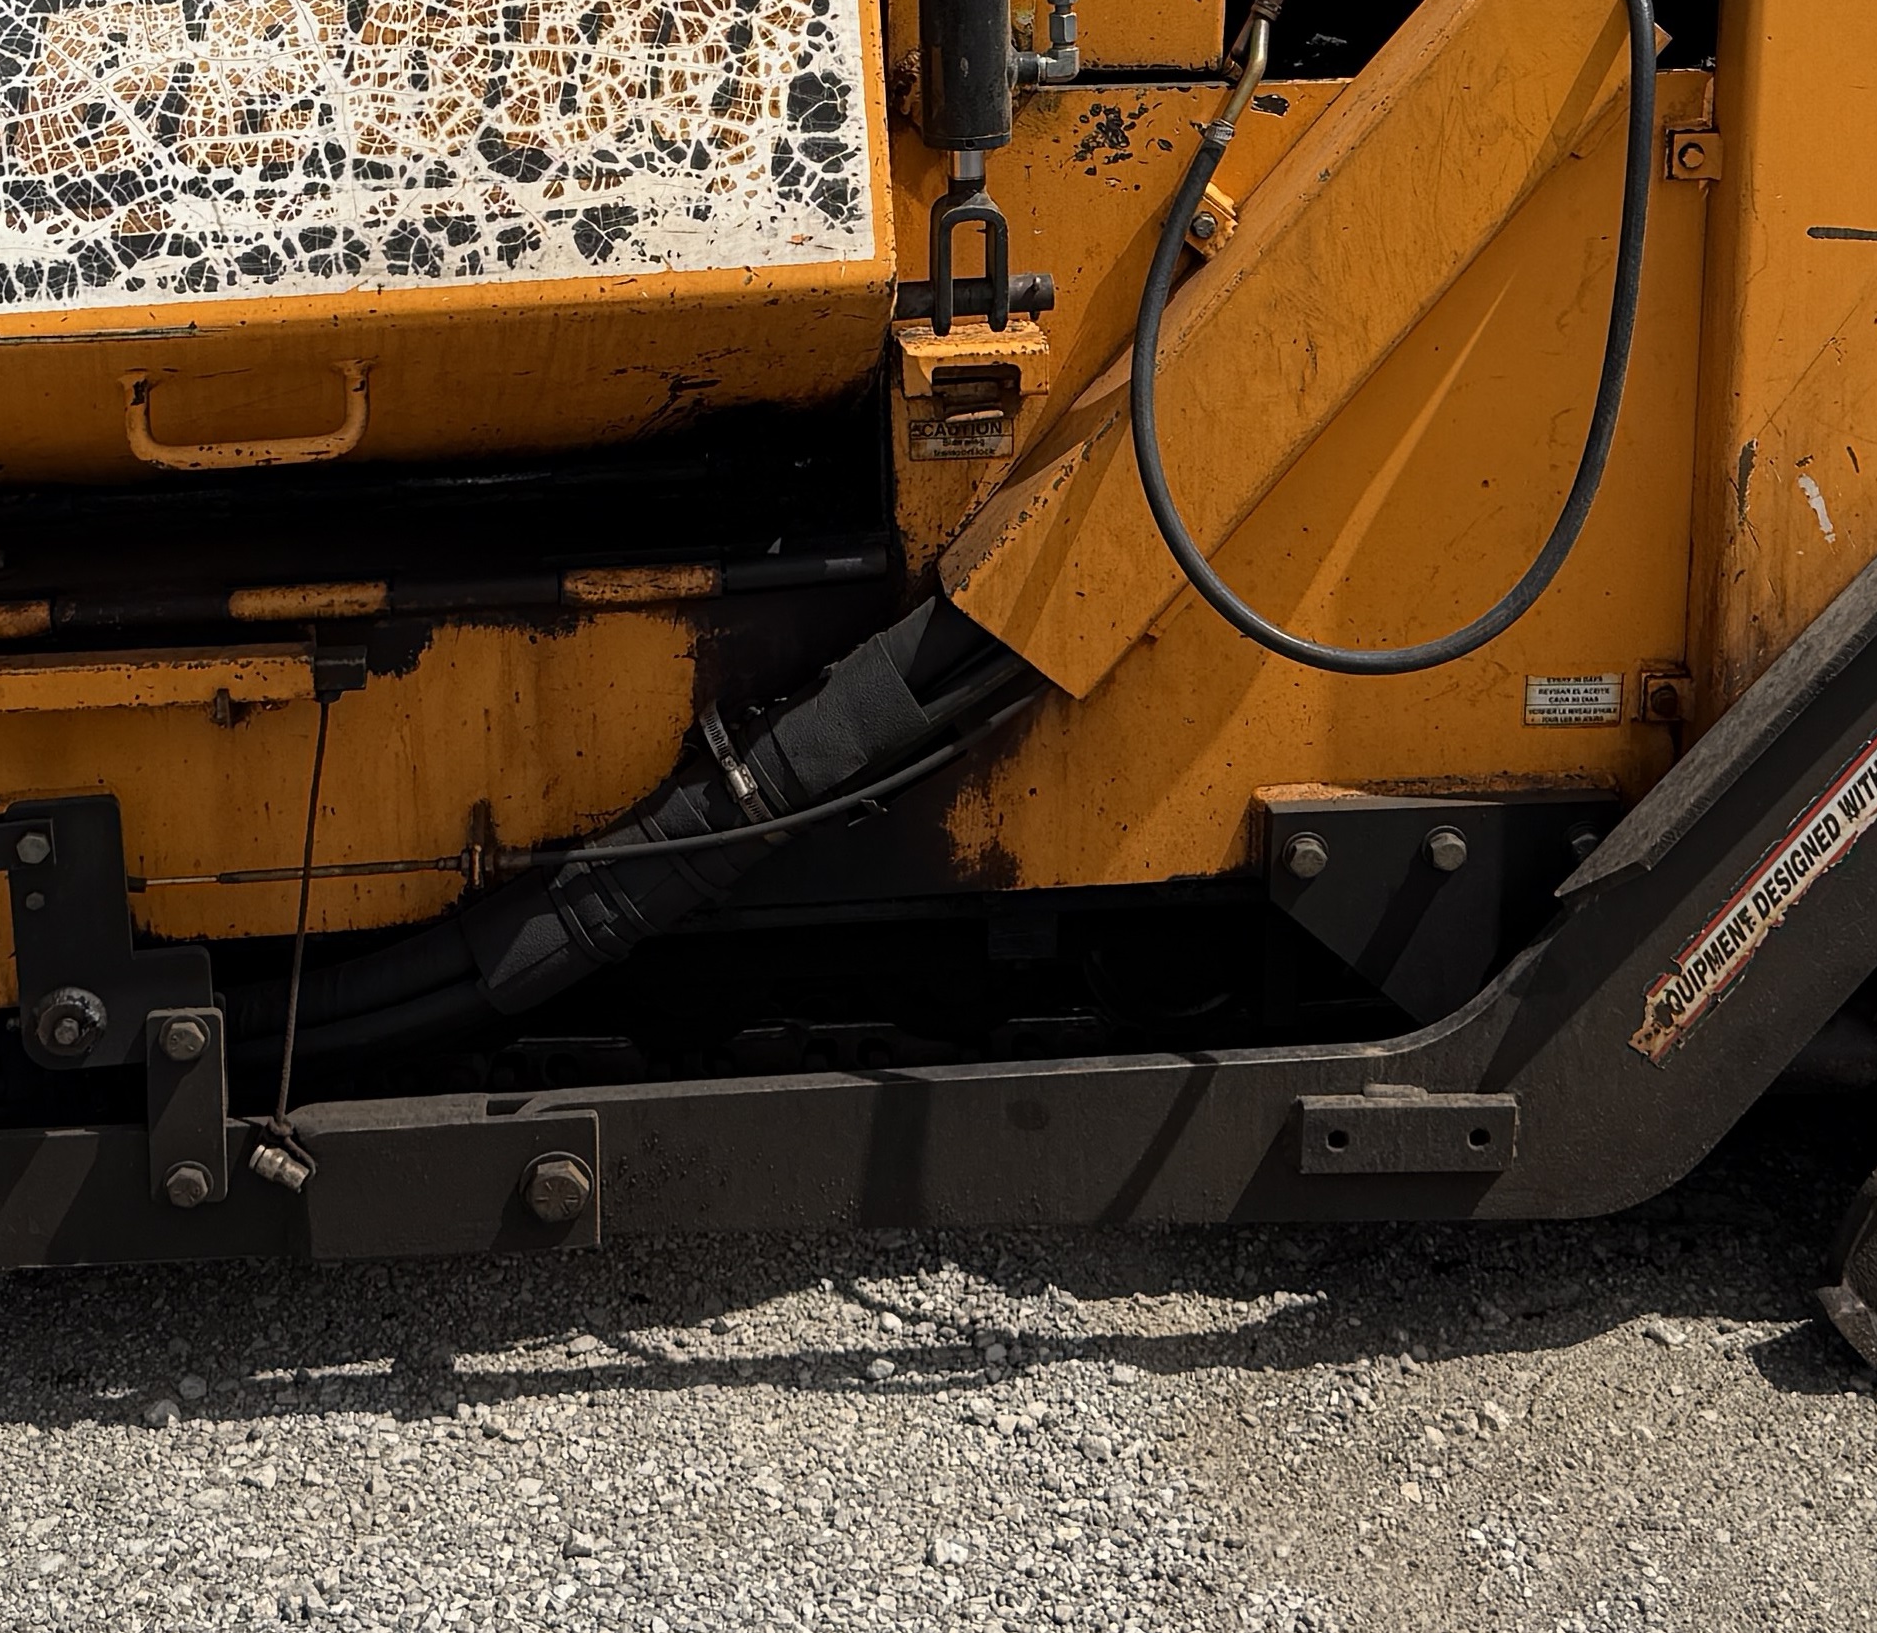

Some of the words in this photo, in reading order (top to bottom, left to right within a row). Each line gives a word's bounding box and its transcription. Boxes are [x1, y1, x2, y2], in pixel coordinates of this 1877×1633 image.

[922, 421, 1002, 437] CAUTION
[1661, 906, 1757, 1020] QUIPMENT
[1752, 813, 1841, 920] DESIGNED
